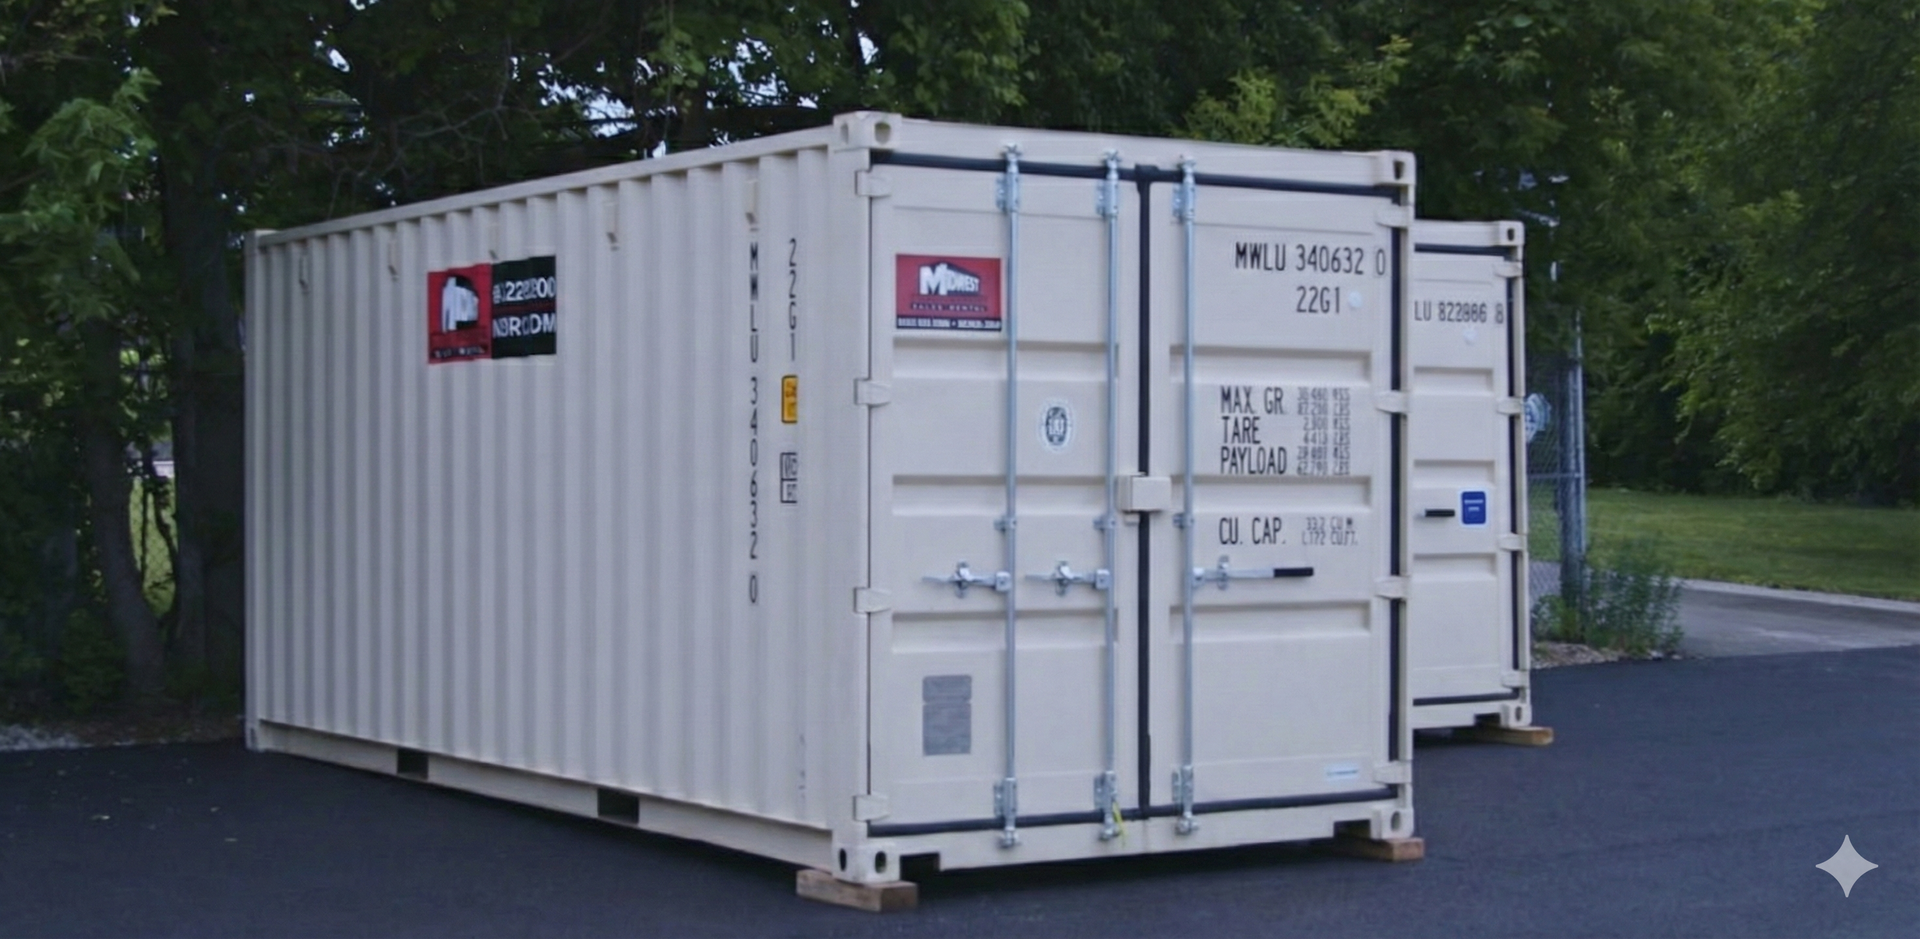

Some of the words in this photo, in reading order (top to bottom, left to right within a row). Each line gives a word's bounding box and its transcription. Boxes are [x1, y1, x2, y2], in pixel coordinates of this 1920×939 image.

[1235, 242, 1286, 271] MWLU
[1295, 244, 1364, 275] 340632
[1375, 248, 1386, 276] 0
[1296, 285, 1341, 315] 22G1
[1221, 416, 1261, 444] TARE
[750, 376, 759, 561] 340632
[1220, 446, 1288, 475] PAYLOAD
[1219, 517, 1243, 545] CU.
[1251, 517, 1286, 545] CAP.
